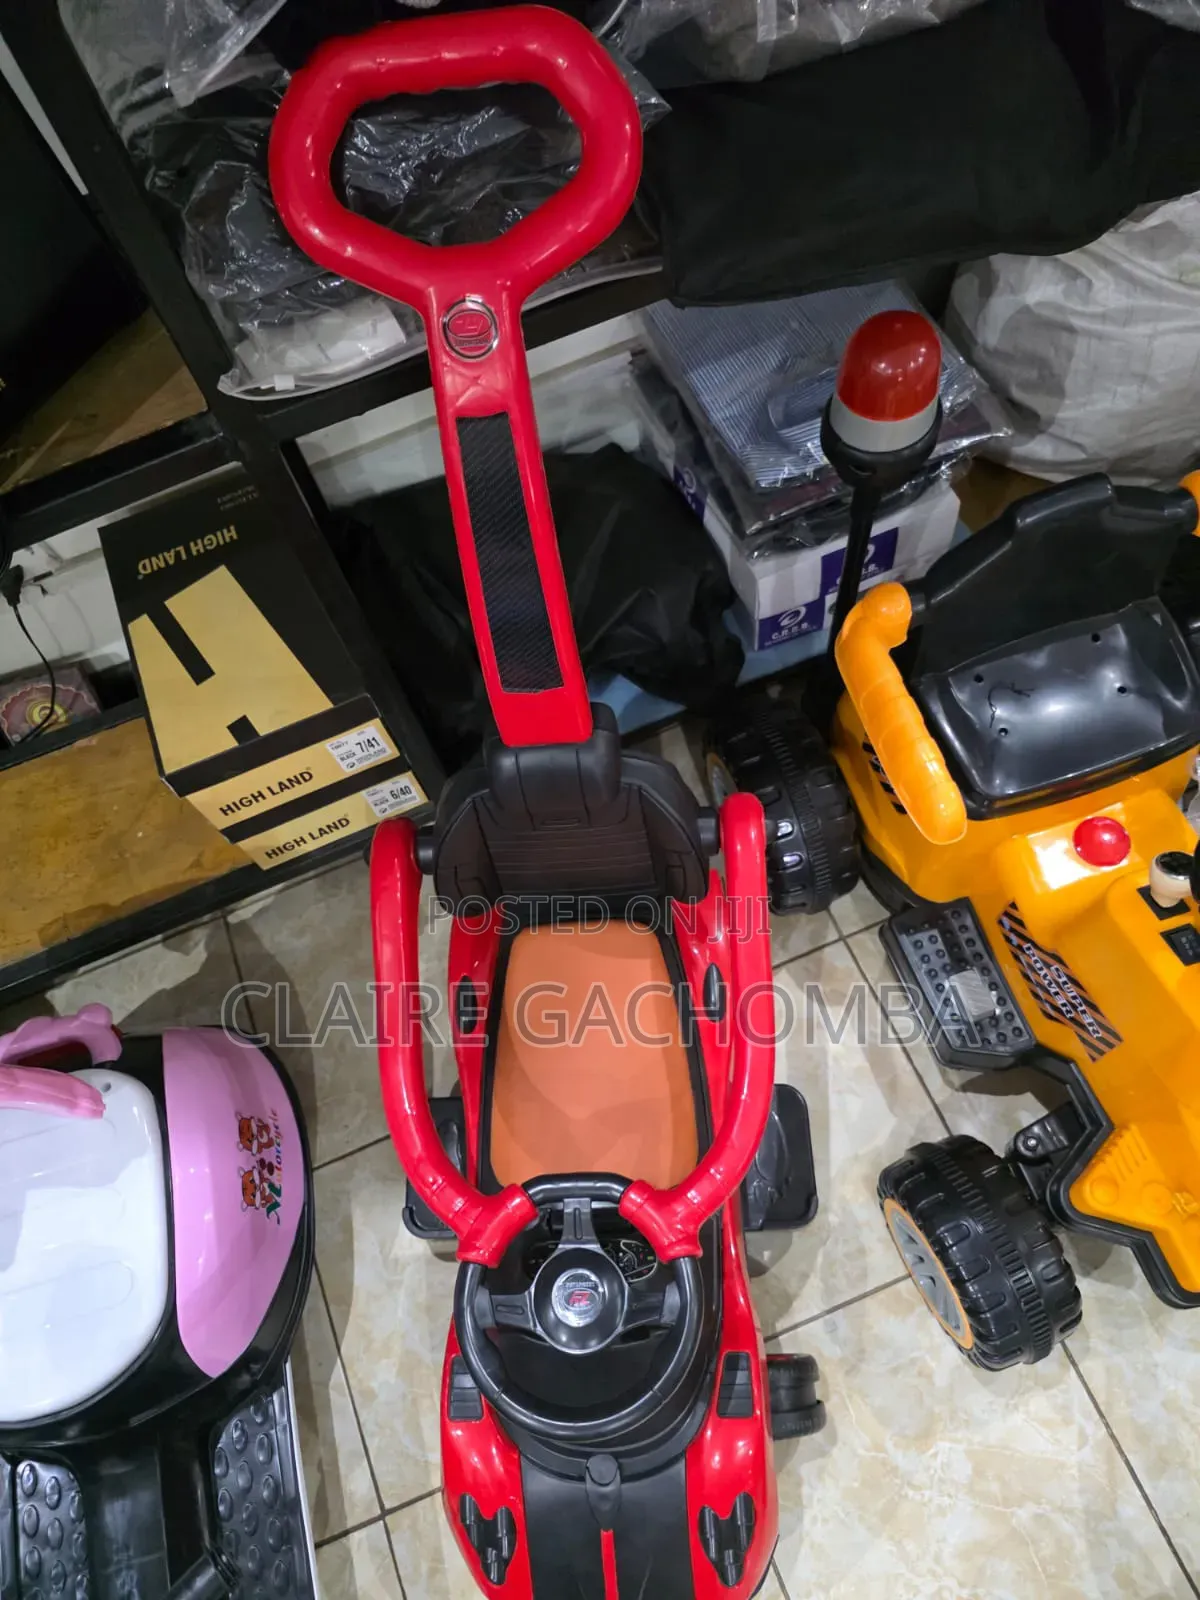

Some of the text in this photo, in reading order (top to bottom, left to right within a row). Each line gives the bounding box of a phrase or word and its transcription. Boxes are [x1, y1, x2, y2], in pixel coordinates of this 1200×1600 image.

[138, 525, 238, 575] HIGH LAND
[219, 770, 314, 816] HIGH LAND
[389, 785, 412, 800] 6/40
[264, 817, 350, 860] HIGH LAND
[1023, 943, 1075, 1018] POWER
[1050, 964, 1102, 1038] SUPER
